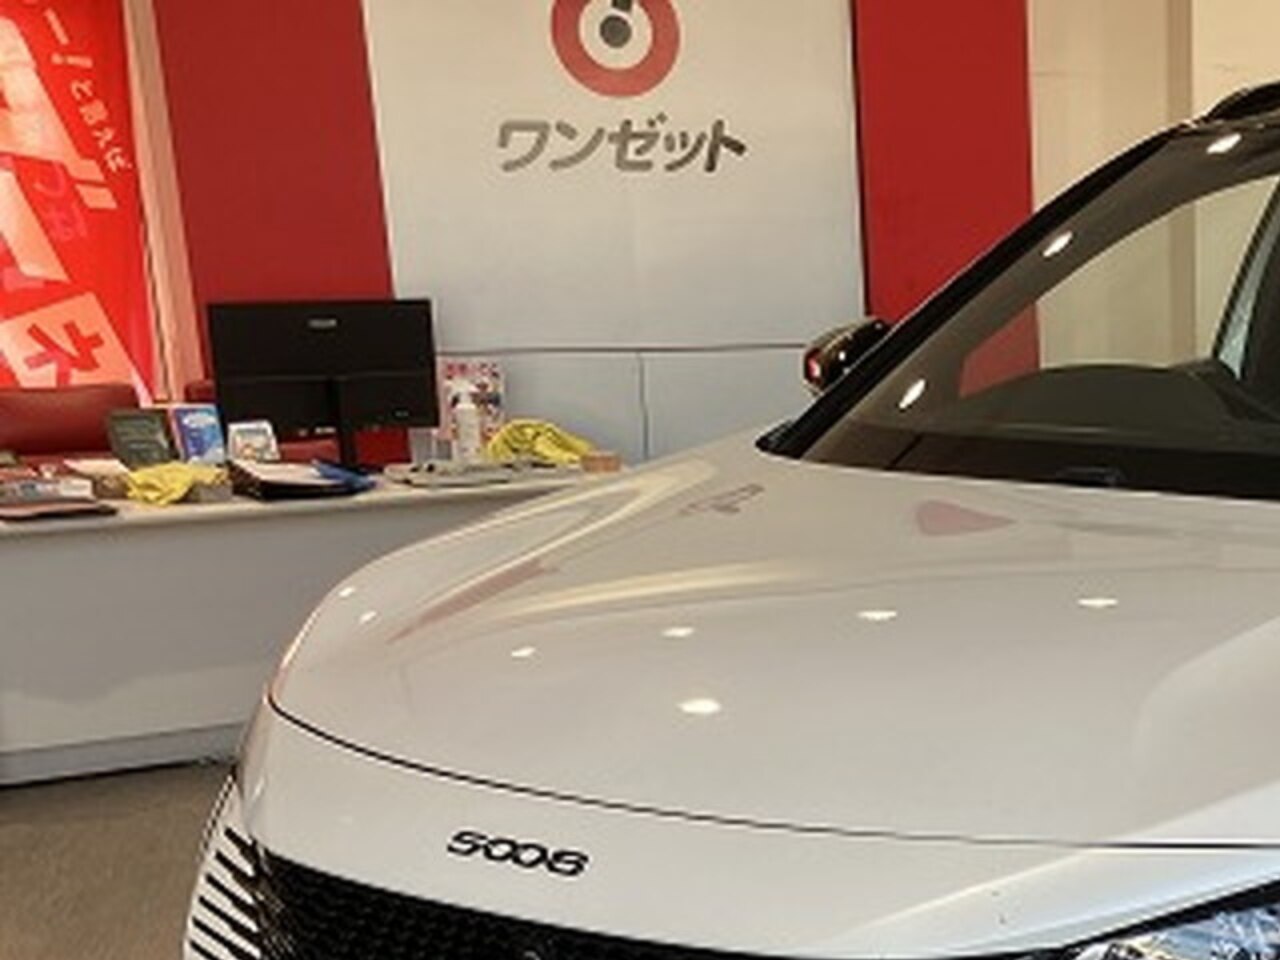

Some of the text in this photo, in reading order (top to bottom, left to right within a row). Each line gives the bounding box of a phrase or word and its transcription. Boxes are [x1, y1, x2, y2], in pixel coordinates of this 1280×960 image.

[498, 112, 747, 172] ワンゼット
[447, 831, 589, 876] 5008
